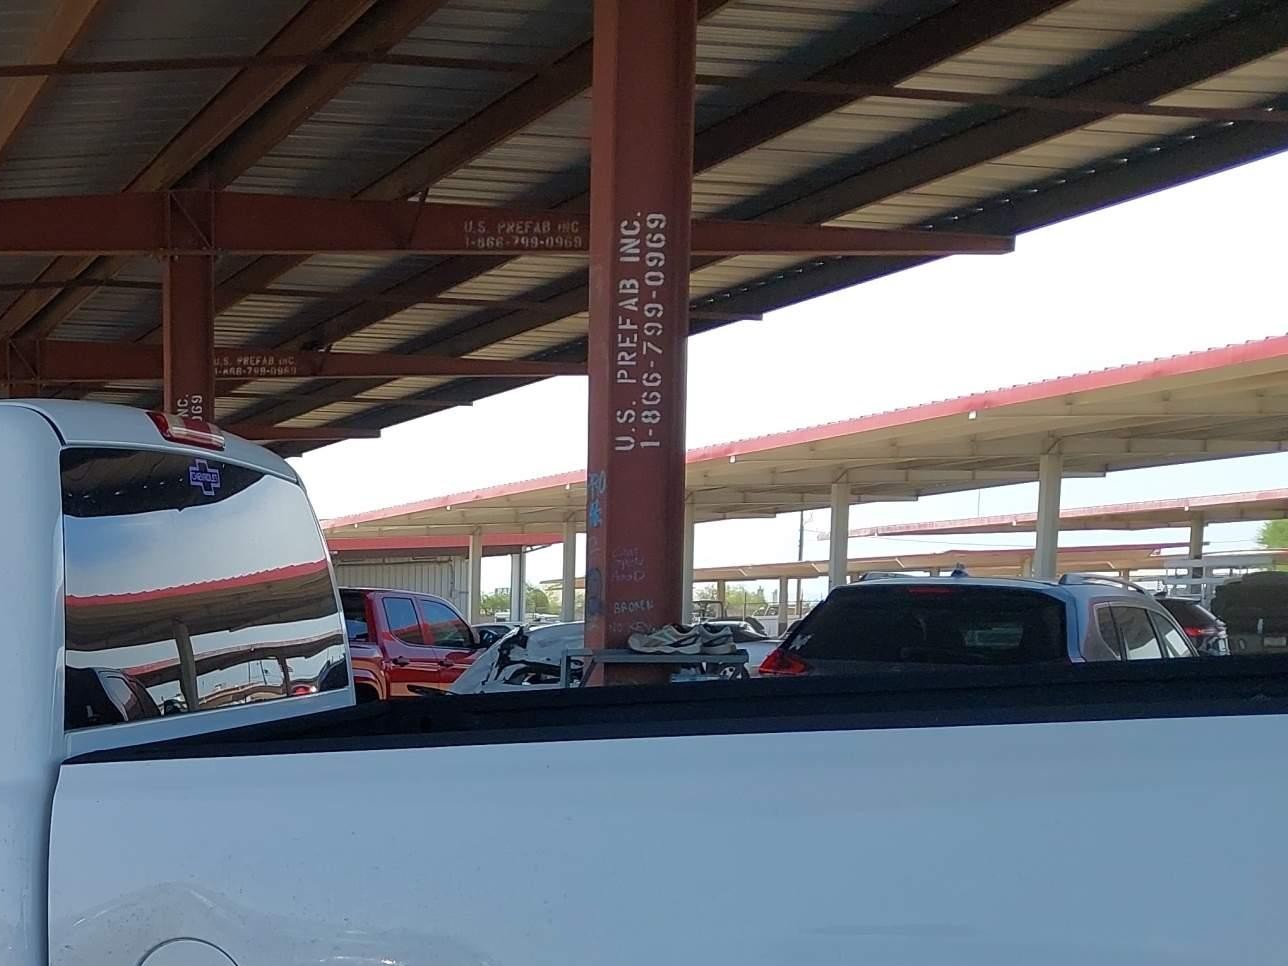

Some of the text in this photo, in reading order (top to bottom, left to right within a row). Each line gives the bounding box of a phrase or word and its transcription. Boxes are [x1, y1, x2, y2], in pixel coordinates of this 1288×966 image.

[497, 220, 551, 234] PREFAB
[465, 236, 583, 249] 1-866-799-0969
[615, 212, 641, 451] U.S. PREFAB INC.
[640, 213, 666, 448] 1-866-799-0969
[177, 394, 189, 417] NC.
